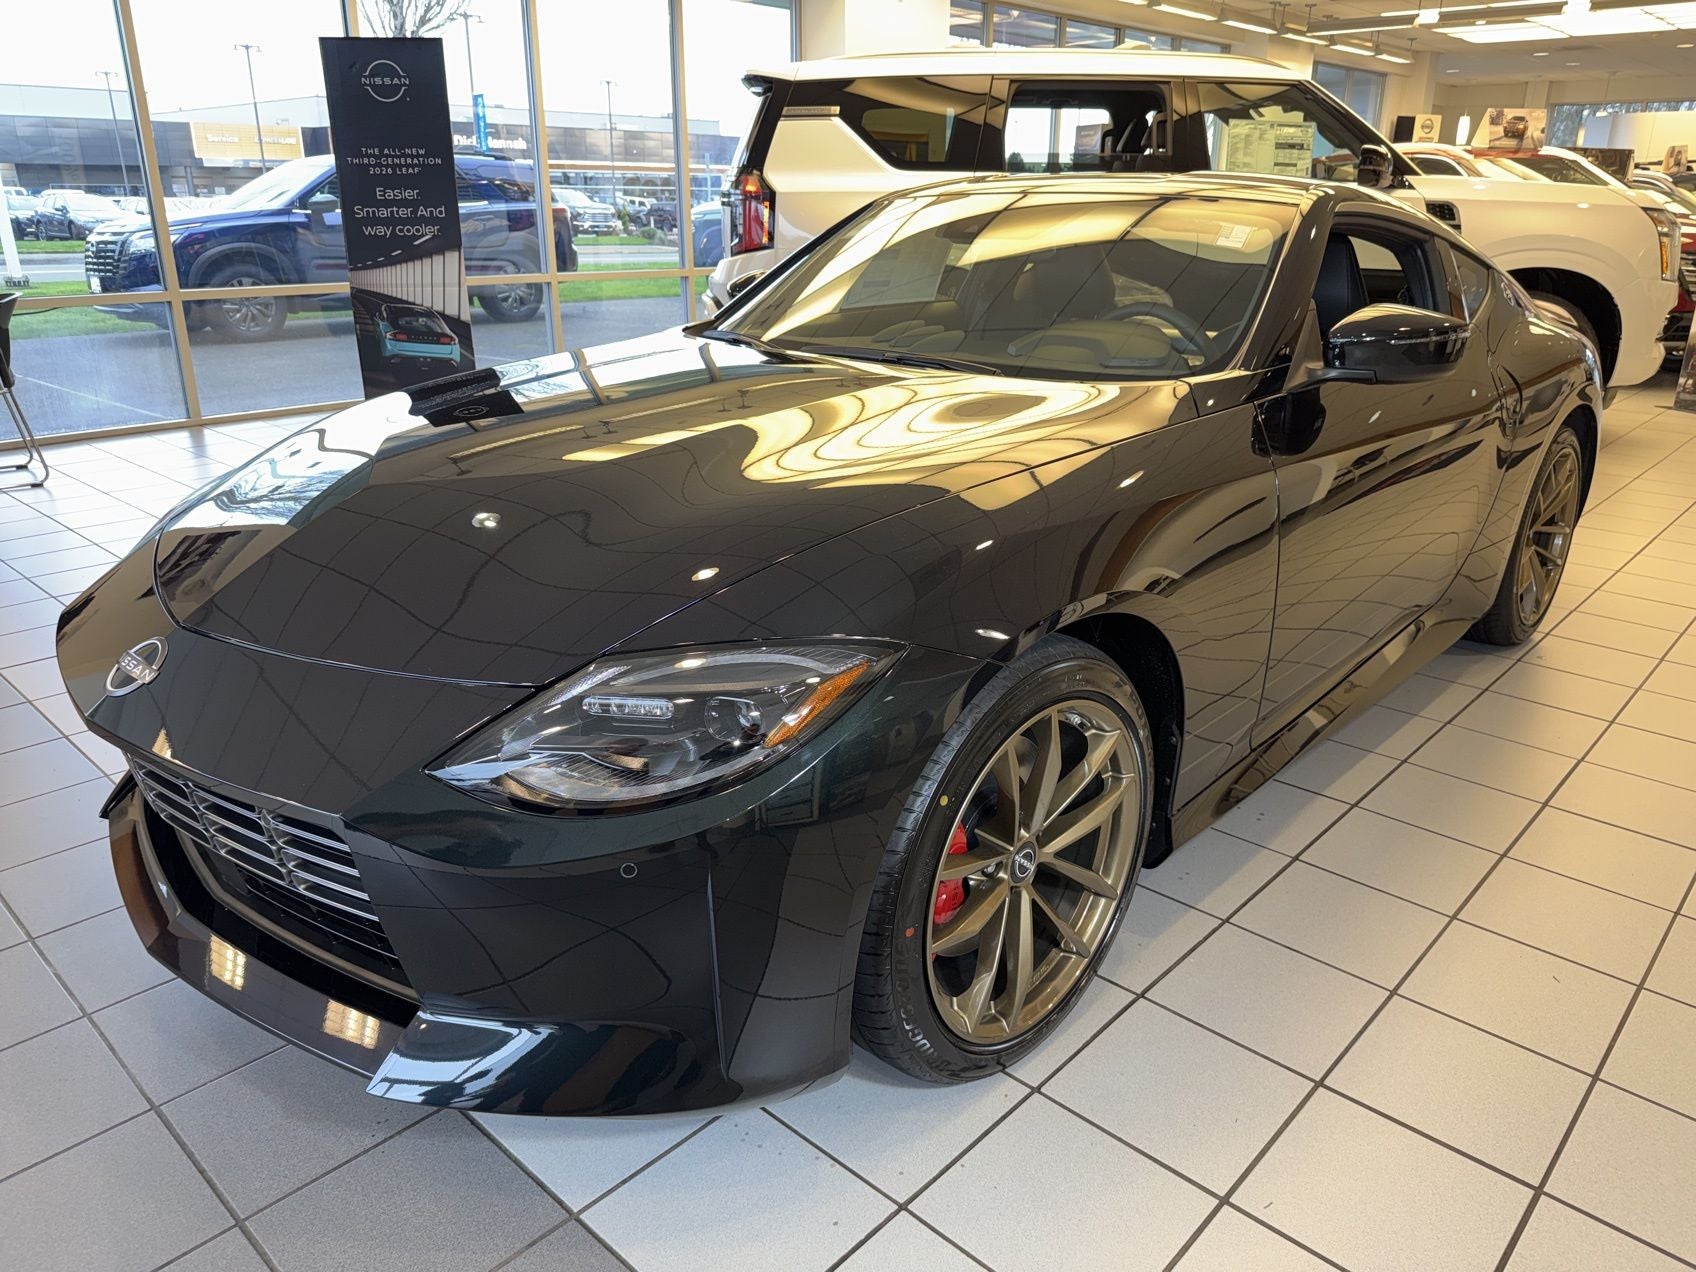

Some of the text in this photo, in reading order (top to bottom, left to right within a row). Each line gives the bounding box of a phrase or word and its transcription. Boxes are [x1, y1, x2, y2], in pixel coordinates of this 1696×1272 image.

[361, 77, 410, 85] NISSAN
[347, 157, 442, 165] THIRD-GENERATION
[369, 167, 393, 175] 2026
[376, 187, 421, 200] Easier.
[354, 205, 445, 218] Smarter. And
[363, 224, 441, 238] way cooler.
[119, 652, 155, 681] ISSAN
